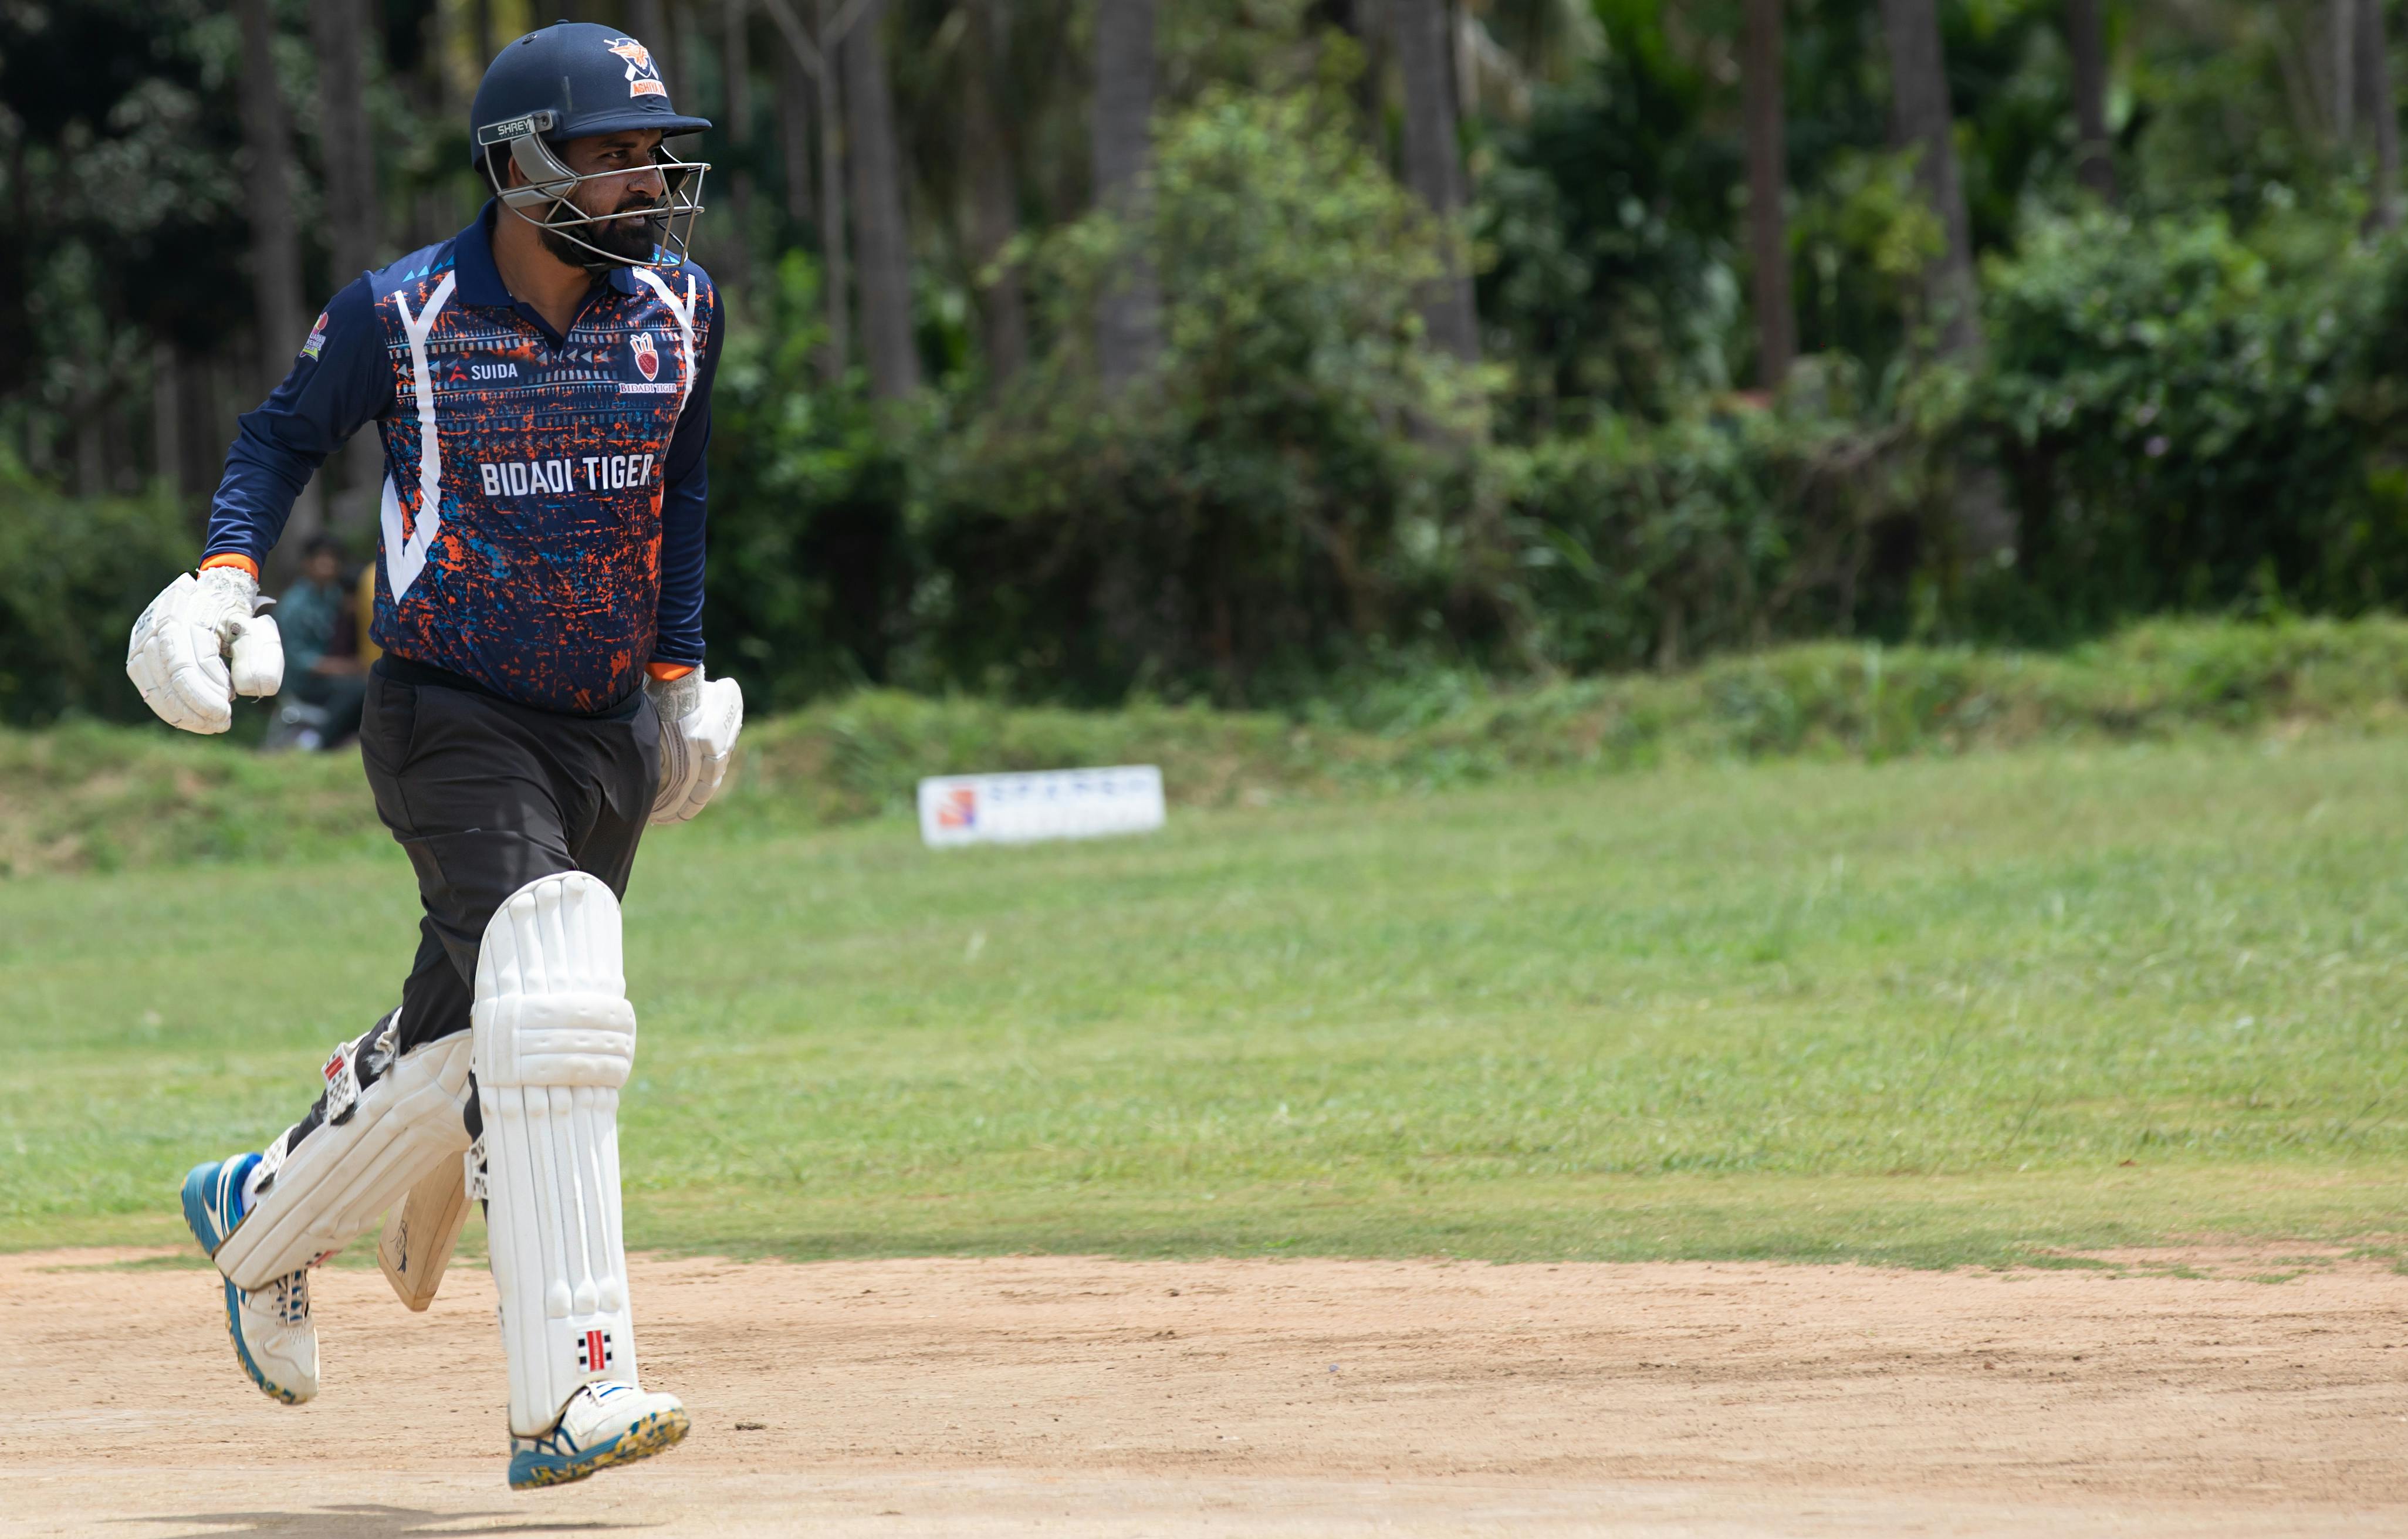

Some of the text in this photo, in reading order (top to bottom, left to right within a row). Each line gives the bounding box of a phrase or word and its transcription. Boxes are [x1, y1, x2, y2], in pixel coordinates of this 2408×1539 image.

[498, 120, 529, 135] SHREY
[471, 363, 518, 380] SUIDA
[620, 384, 677, 392] BIDADI TIGER
[480, 454, 654, 496] BIDADI TIGER
